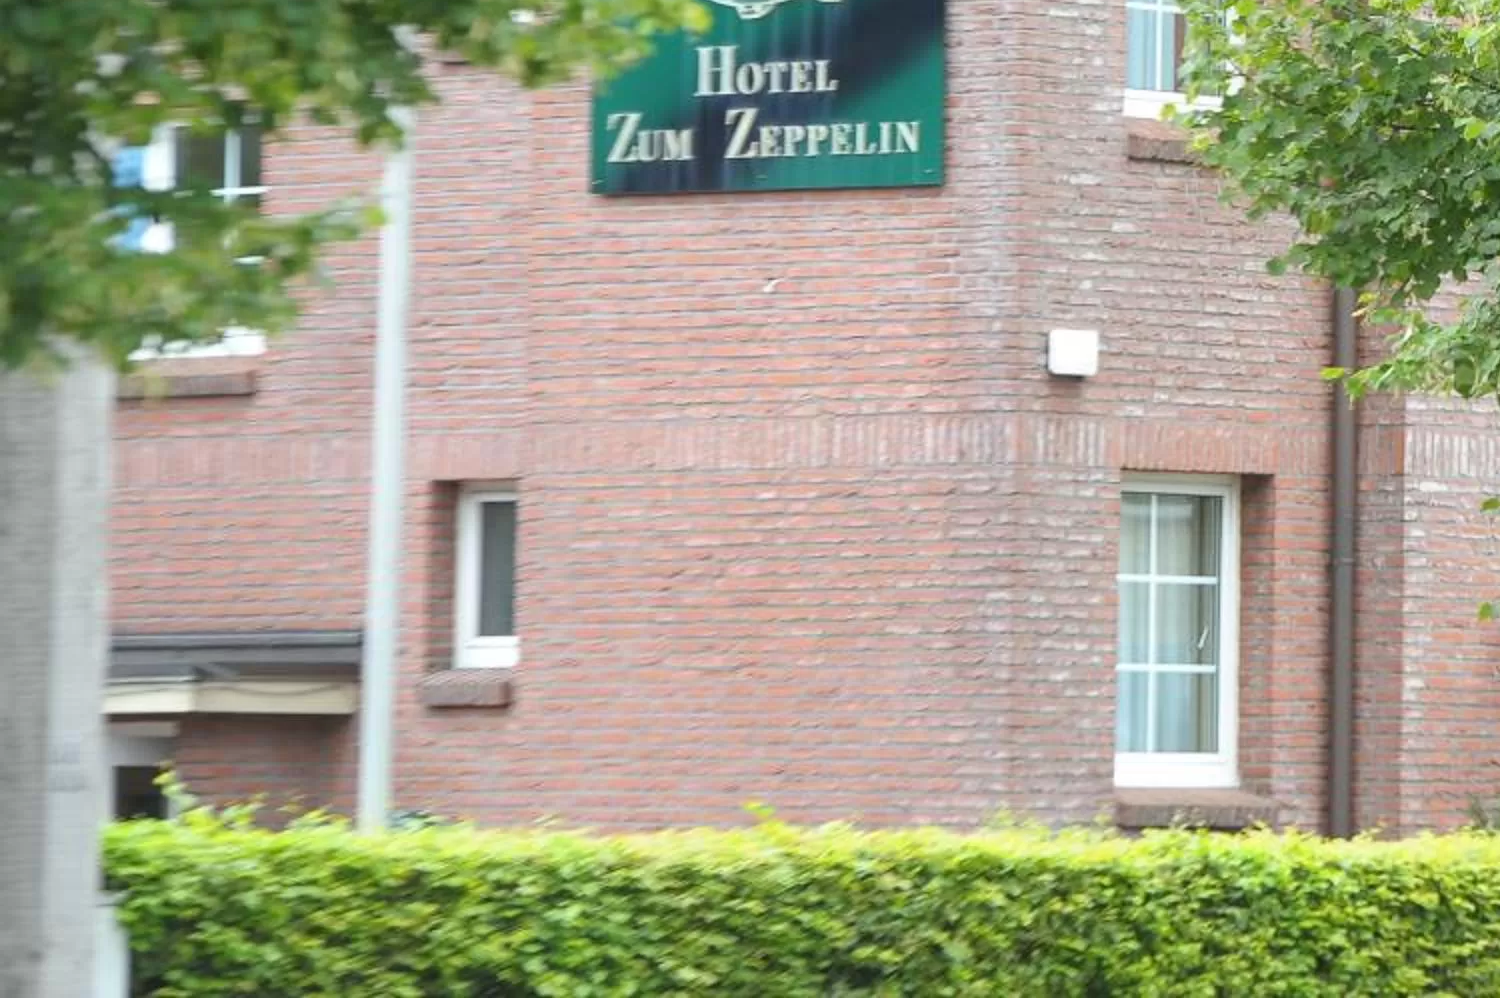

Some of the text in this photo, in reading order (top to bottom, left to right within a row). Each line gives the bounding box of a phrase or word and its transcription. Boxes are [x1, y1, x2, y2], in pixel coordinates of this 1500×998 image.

[695, 45, 838, 96] HOTEL
[607, 107, 920, 162] ZUM ZEPPELIN
